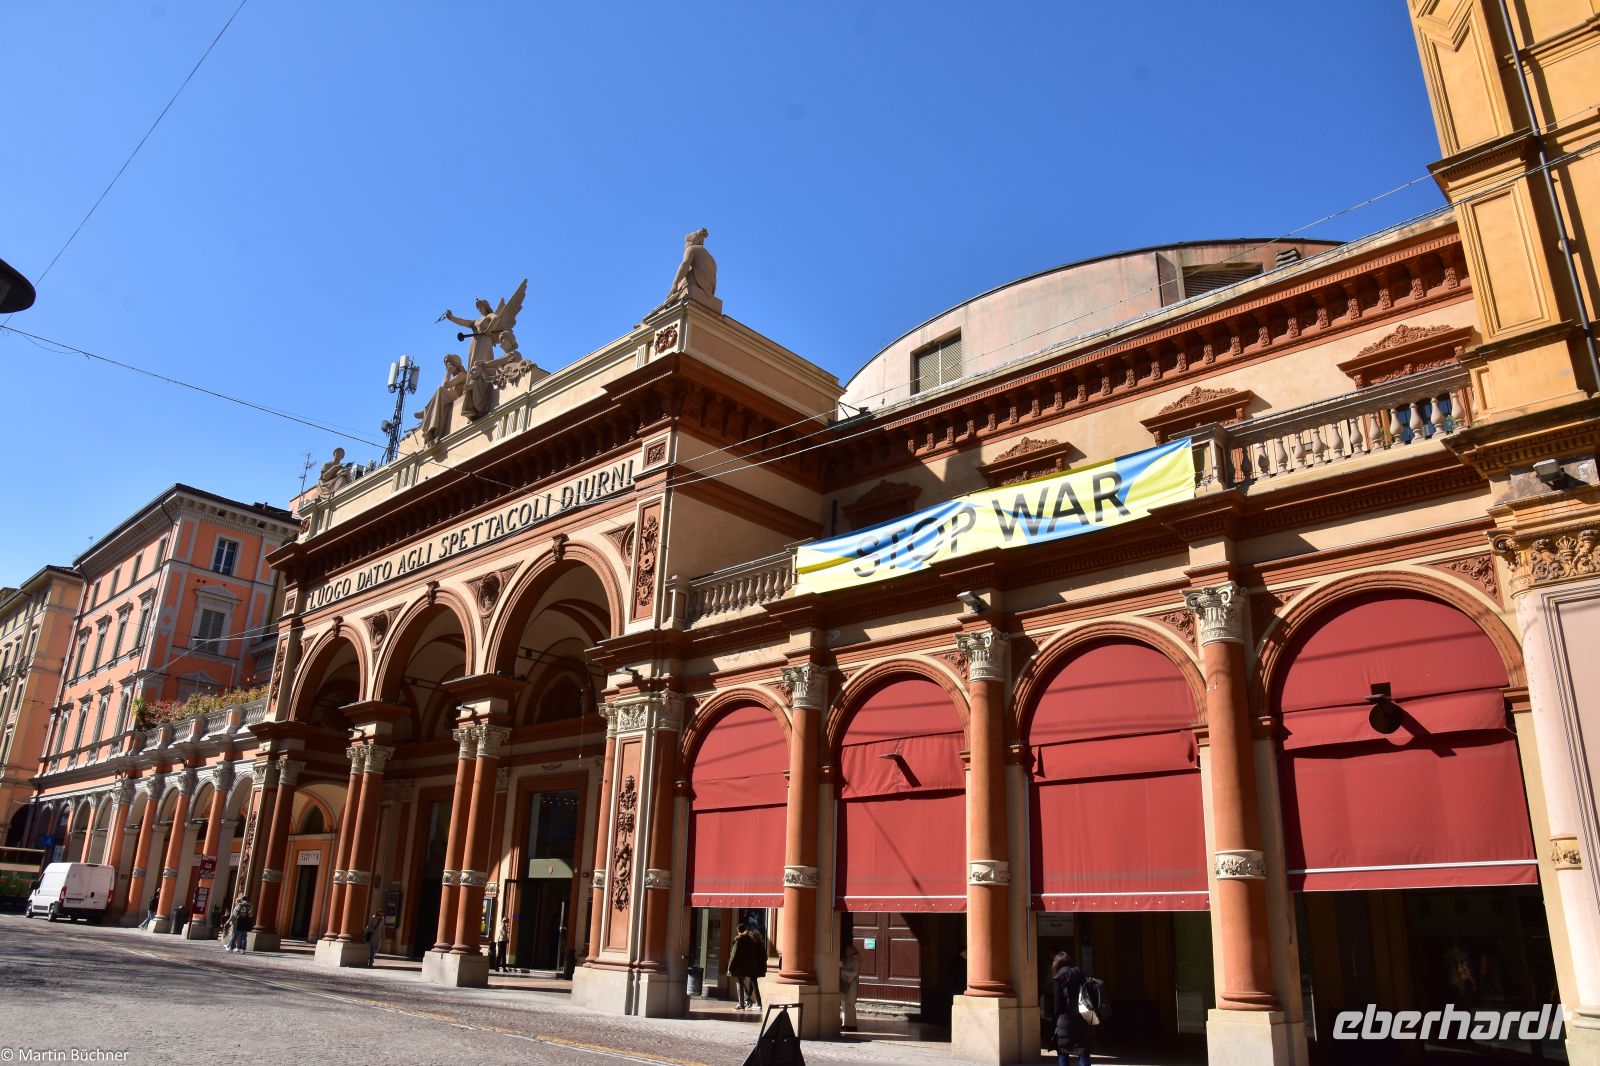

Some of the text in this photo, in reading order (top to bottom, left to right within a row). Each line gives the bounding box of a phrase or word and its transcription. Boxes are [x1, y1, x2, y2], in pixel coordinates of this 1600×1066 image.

[309, 459, 635, 610] LUOGO DATO AGLI SPETTACOLI DIURNI
[853, 470, 1131, 577] STOP WAR
